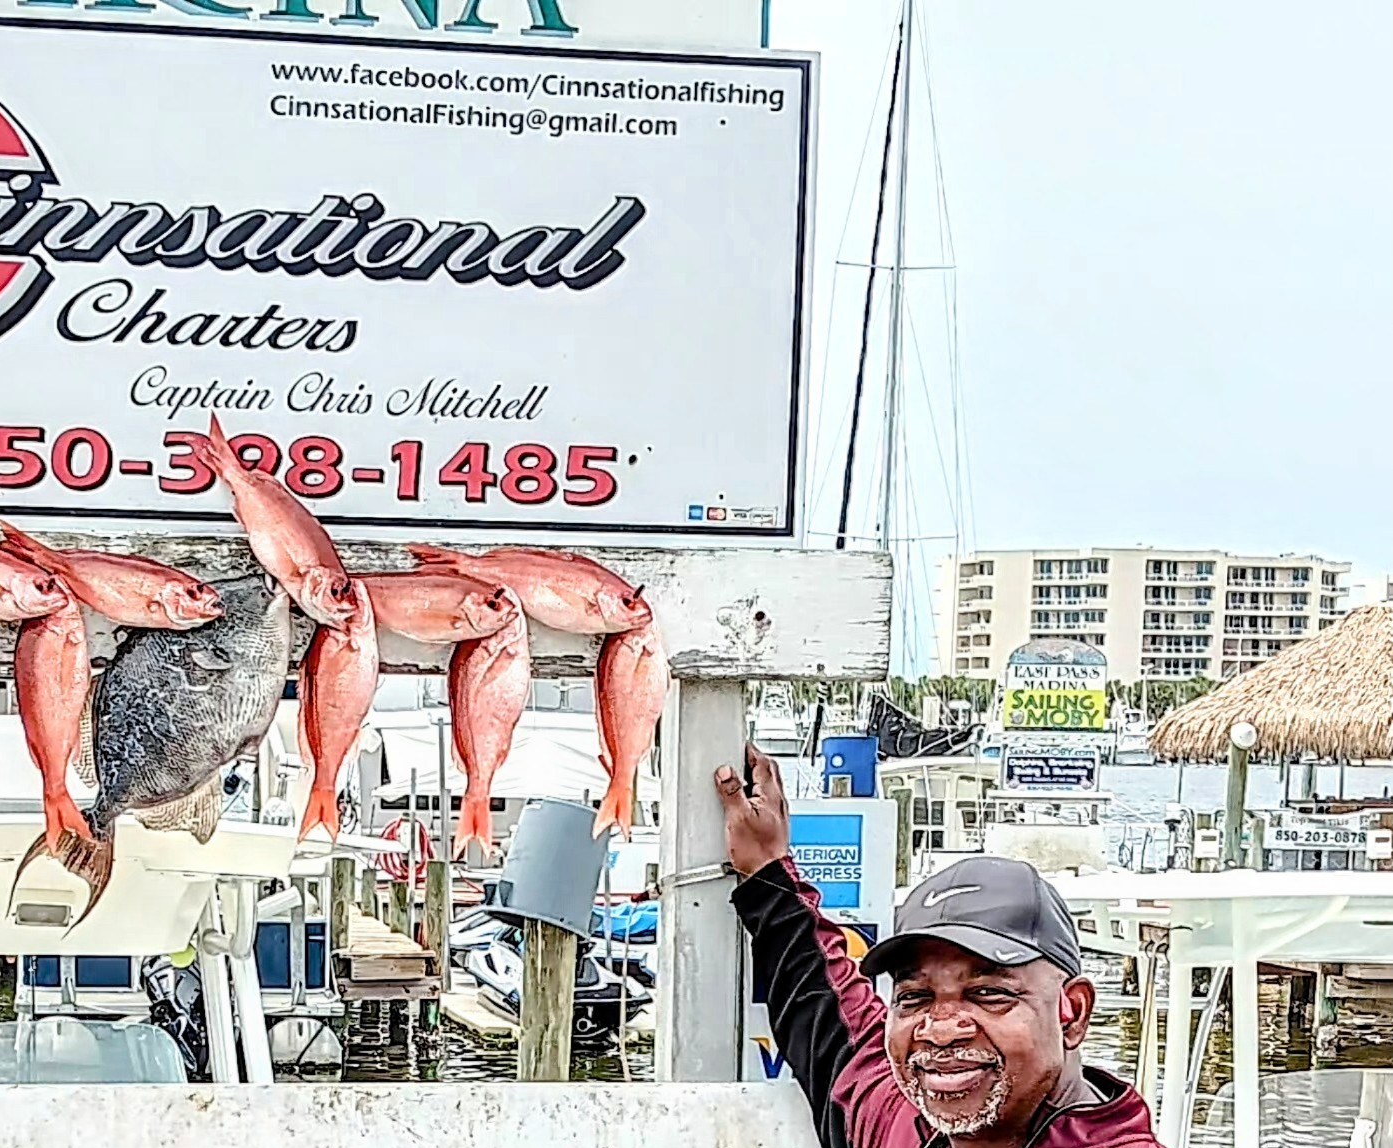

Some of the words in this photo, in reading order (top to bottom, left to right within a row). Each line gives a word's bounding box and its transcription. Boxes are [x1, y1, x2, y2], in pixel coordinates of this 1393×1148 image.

[271, 61, 785, 111] www.facebook.com/Cinnsationalfishing
[269, 94, 678, 138] CinnsationalFishing@gmail.com
[56, 278, 359, 352] Charters
[130, 366, 274, 420] Captain
[286, 371, 373, 416] Chris
[386, 378, 549, 421] Mitchell
[1014, 666, 1051, 678] EAST
[1057, 666, 1100, 679] PASS
[1011, 689, 1095, 710] SAILING
[1026, 709, 1100, 727] MOBY
[1275, 830, 1367, 844] 850-203-0878
[787, 848, 857, 862] MERICAN
